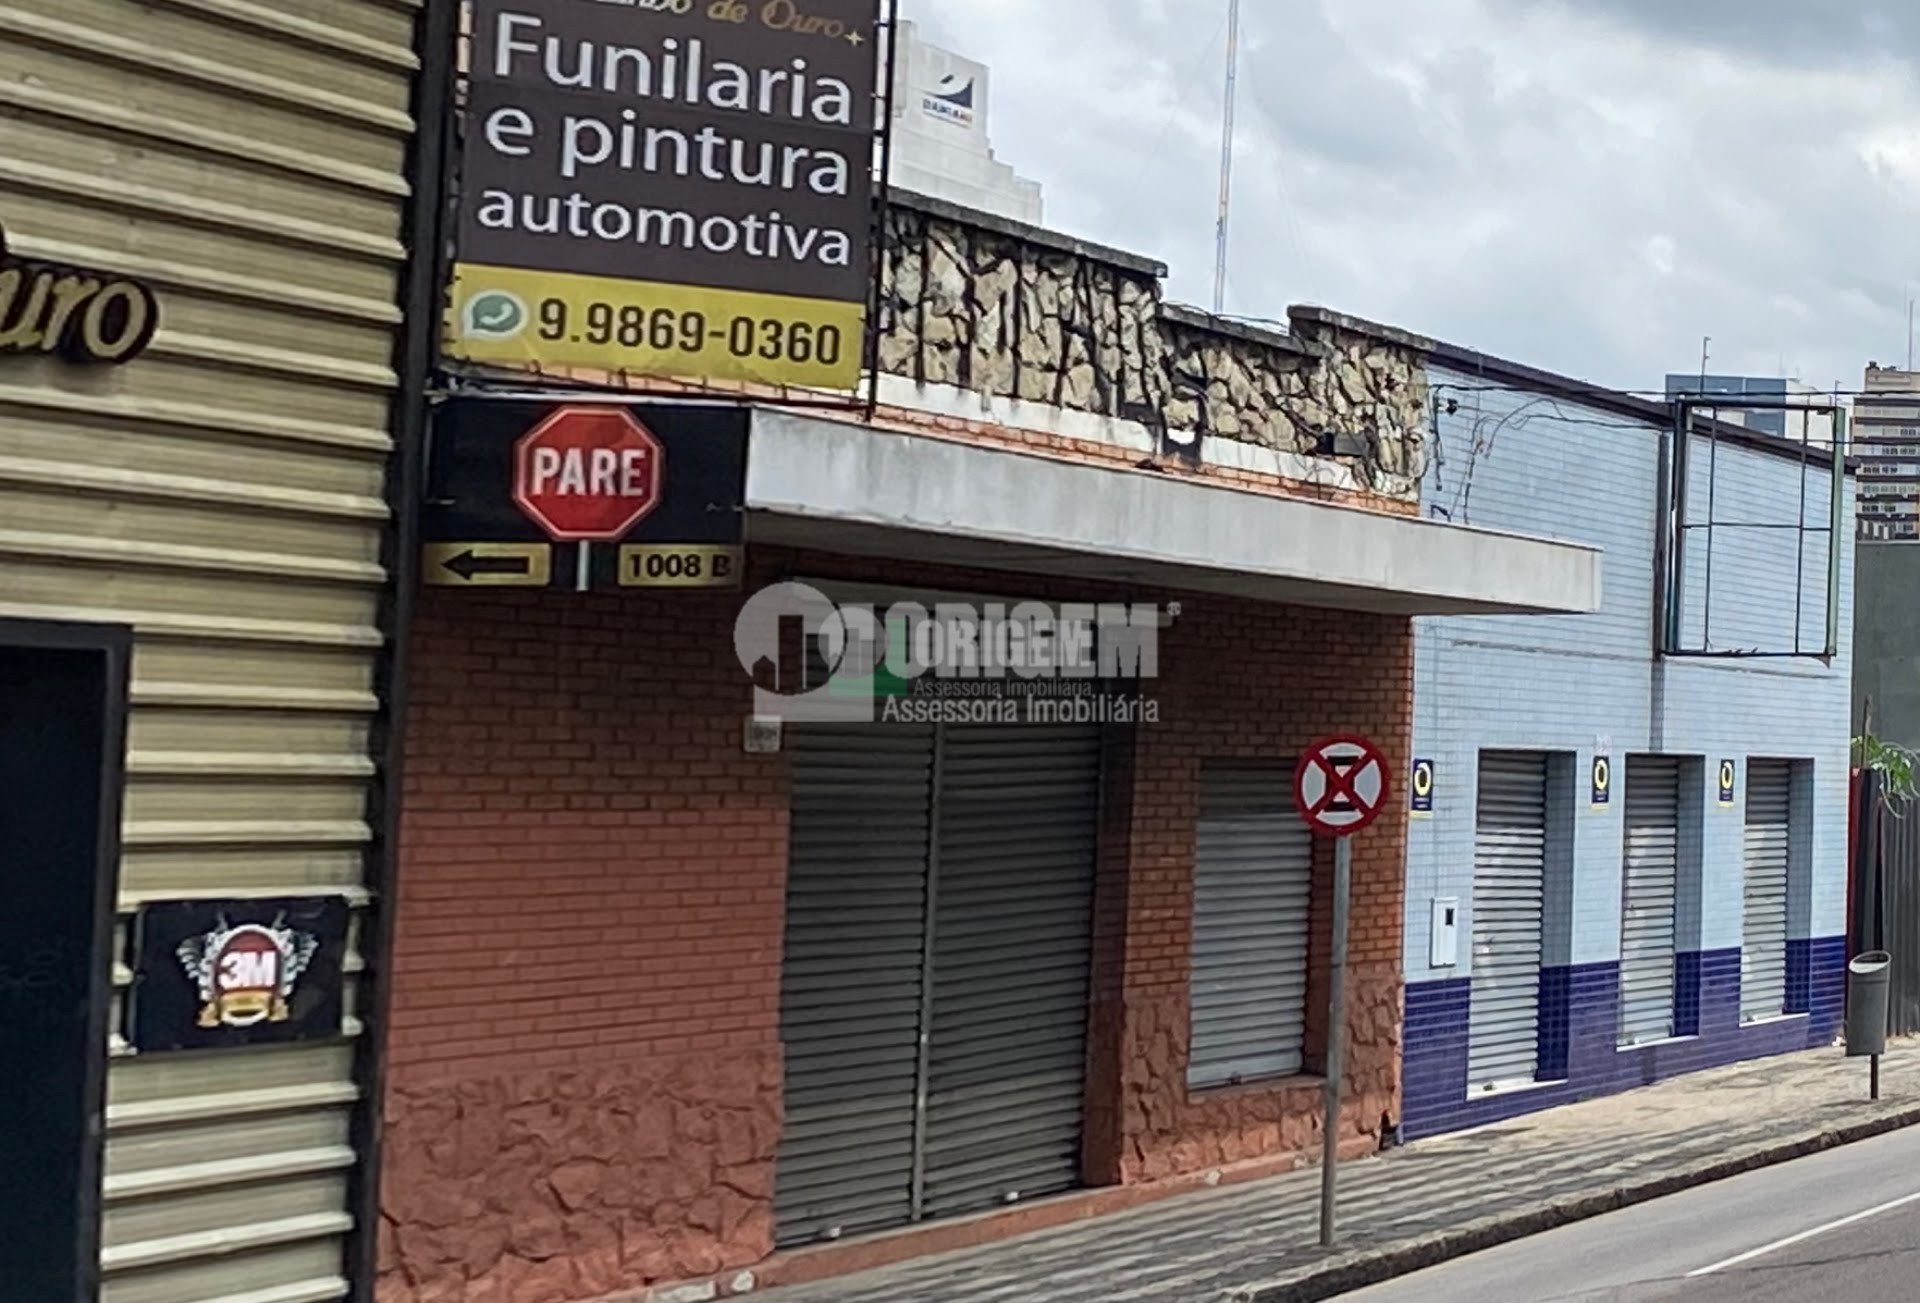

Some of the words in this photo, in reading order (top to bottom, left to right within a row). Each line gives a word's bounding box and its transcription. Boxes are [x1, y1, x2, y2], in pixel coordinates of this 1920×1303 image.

[761, 0, 845, 38] Ouro
[495, 12, 851, 125] Funilaria
[485, 106, 534, 155] e
[561, 108, 848, 196] pintura
[478, 189, 850, 266] automotiva
[0, 268, 150, 358] uro
[538, 298, 841, 366] 9.9869-0360
[530, 447, 645, 497] PARE
[629, 553, 702, 578] 1008
[218, 951, 276, 990] 3M
